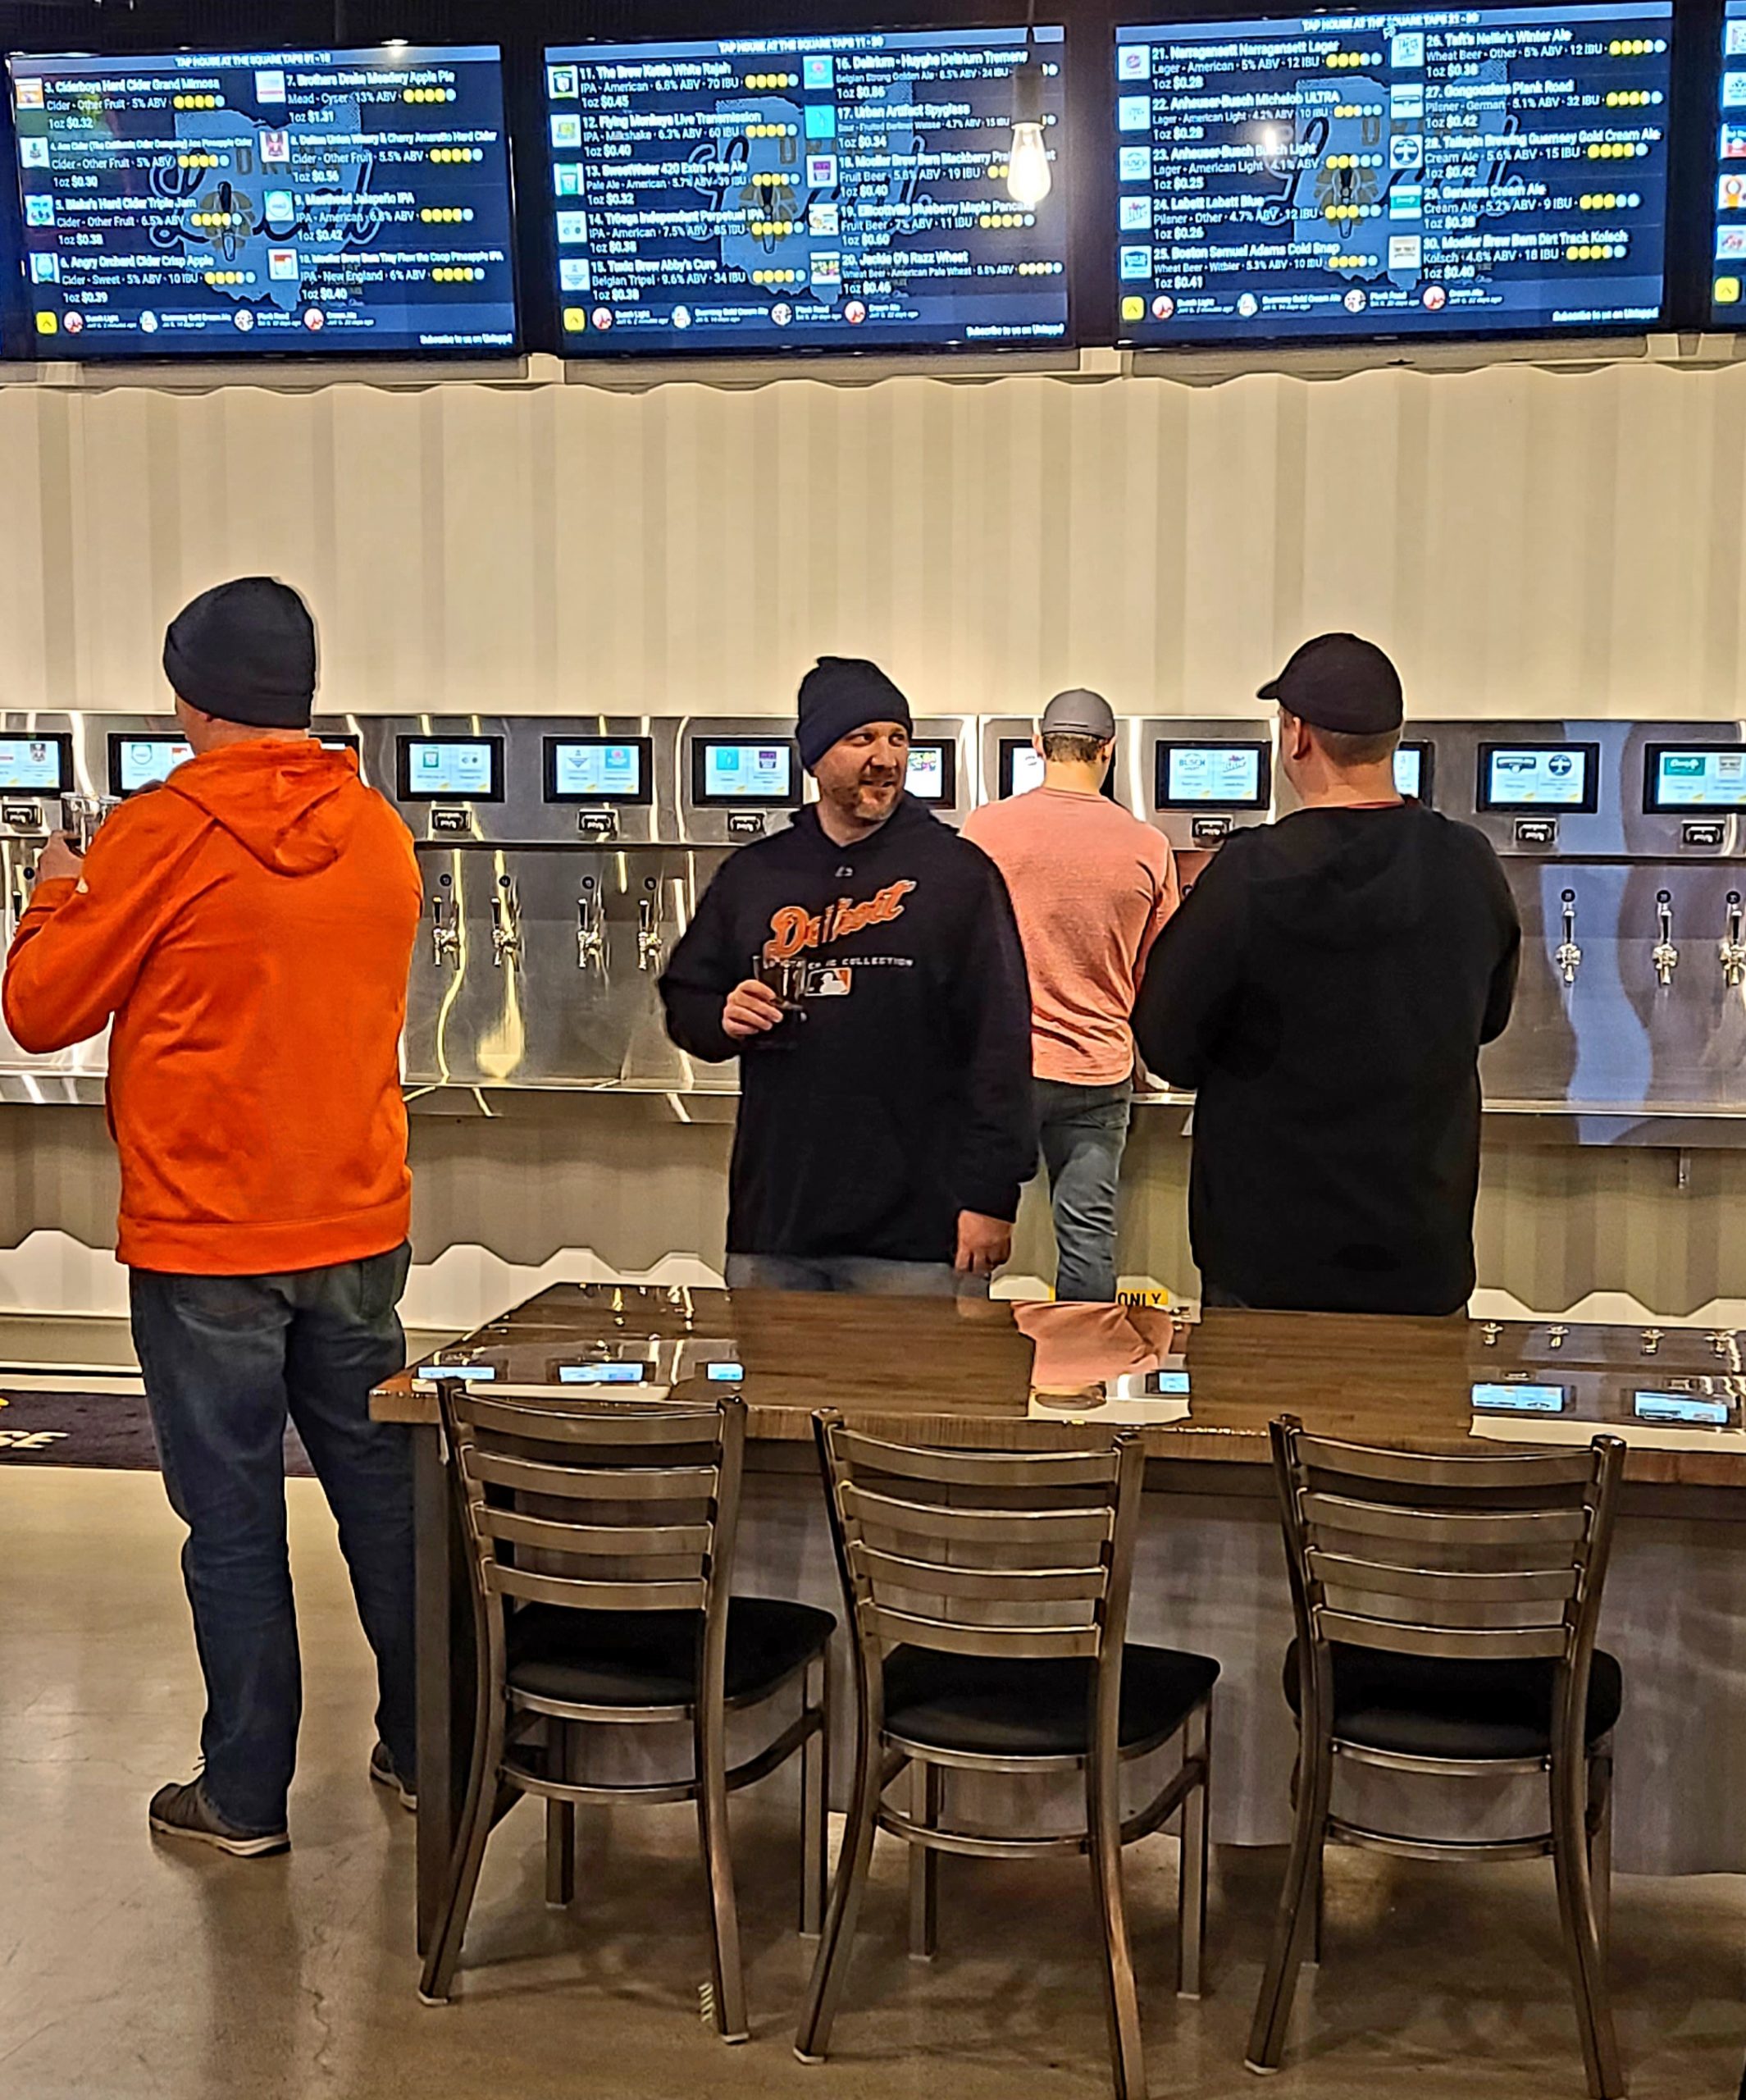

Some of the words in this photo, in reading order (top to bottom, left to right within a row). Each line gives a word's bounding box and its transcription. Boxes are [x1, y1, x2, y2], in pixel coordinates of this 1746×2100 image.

[1427, 51, 1457, 62] Wheat
[1460, 50, 1482, 60] Beer
[1489, 48, 1516, 58] Other
[1525, 47, 1539, 57] 5%
[1541, 45, 1562, 57] ABV
[1570, 44, 1583, 55] 12
[1584, 43, 1602, 54] IBU
[580, 67, 595, 80] 11.
[596, 66, 615, 79] The
[672, 64, 701, 76] White
[703, 62, 731, 76] Rajah
[1153, 64, 1180, 75] Lager
[1188, 62, 1233, 72] American
[1242, 59, 1256, 70] 5%
[1258, 58, 1279, 70] ABV
[1288, 57, 1300, 68] 12
[1302, 57, 1320, 67] IBU
[1427, 66, 1445, 77] 1oz
[410, 71, 437, 85] Apple
[438, 71, 454, 82] Pie
[581, 83, 597, 93] IPA
[604, 82, 649, 92] American
[680, 79, 700, 90] ABV
[707, 78, 720, 89] 70
[722, 77, 738, 89] IBU
[1153, 79, 1171, 89] 1oz
[47, 101, 71, 110] Cider
[78, 98, 102, 112] Other
[104, 98, 125, 109] Fruit
[132, 98, 146, 108] 5%
[148, 98, 166, 107] ABV
[288, 93, 314, 103] Mead
[321, 93, 349, 106] Cyser
[355, 92, 375, 103] 13%
[376, 91, 396, 102] ABV
[582, 98, 599, 107] 1oz
[601, 95, 629, 109] $0.45
[49, 119, 65, 129] 1oz
[66, 116, 93, 129] $0.32
[289, 112, 306, 125] 1oz
[308, 110, 333, 123] $1.31
[583, 116, 598, 129] 12.
[599, 116, 628, 130] Flying
[674, 114, 695, 126] Live
[695, 112, 761, 125] Transmission
[1426, 117, 1444, 128] 1oz
[1447, 114, 1477, 129] $0.42
[584, 131, 599, 142] IPA
[606, 130, 651, 140] Milkshake
[659, 129, 681, 139] 6.3%
[682, 128, 702, 139] ABV
[709, 127, 721, 140] 60
[723, 126, 739, 138] IBU
[839, 138, 856, 148] 1oz
[859, 135, 887, 148] $0.34
[585, 147, 602, 157] 1oz
[604, 144, 631, 158] $0.40
[293, 172, 310, 182] 1oz
[312, 170, 339, 182] $0.56
[1154, 179, 1172, 190] 1oz
[1174, 176, 1204, 190] $0.25
[1424, 188, 1441, 200] 29.
[1490, 183, 1525, 198] Cream
[1527, 183, 1546, 195] Ale
[588, 194, 604, 205] 1oz
[606, 193, 634, 205] $0.32
[1154, 199, 1169, 211] 24.
[1171, 197, 1205, 210] Labatt
[1206, 196, 1238, 208] Labatt
[1241, 195, 1265, 208] Blue
[1424, 203, 1458, 213] Cream
[1461, 201, 1479, 215] Ale
[1513, 199, 1536, 211] ABV
[1544, 198, 1551, 209] 9
[1553, 197, 1572, 208] IBU
[1154, 214, 1188, 225] Pilsner
[1195, 212, 1222, 222] Other
[1229, 211, 1253, 221] 4.7%
[1256, 209, 1279, 222] ABV
[1284, 209, 1298, 221] 12
[1300, 208, 1318, 219] IBU
[841, 220, 863, 231] Fruit
[865, 220, 887, 231] Beer
[893, 218, 911, 231] 7%
[912, 218, 932, 229] ABV
[941, 217, 951, 228] 11
[955, 217, 972, 228] IBU
[59, 235, 75, 244] 1oz
[298, 230, 314, 241] 1oz
[316, 229, 343, 241] $0.42
[842, 235, 859, 245] 1oz
[1155, 229, 1172, 240] 1oz
[1174, 226, 1204, 240] $0.26
[1154, 248, 1169, 260] 25.
[1172, 247, 1208, 259] Boston
[1249, 244, 1286, 256] Adams
[1288, 242, 1311, 255] Cold
[1313, 242, 1340, 255] Snap
[842, 254, 858, 266] 20.
[859, 253, 892, 266] Jackie
[910, 253, 935, 264] Razz
[936, 251, 968, 263] Wheat
[62, 275, 85, 285] Cider
[93, 275, 121, 284] Sweet
[127, 274, 140, 284] 5%
[142, 274, 162, 284] ABV
[169, 274, 180, 284] 10
[182, 272, 198, 283] IBU
[301, 272, 317, 282] IPA
[323, 272, 344, 281] New
[346, 270, 383, 284] England
[390, 270, 403, 281] 6%
[406, 269, 426, 280] ABV
[1424, 268, 1442, 279] 1oz
[1444, 265, 1475, 279] $0.40
[592, 276, 627, 288] Belgian
[628, 274, 655, 286] Tripel
[662, 274, 685, 284] 9.6%
[686, 273, 707, 284] ABV
[714, 272, 727, 283] 34
[729, 272, 745, 283] IBU
[1155, 278, 1172, 289] 1oz
[1174, 276, 1202, 289] $0.41
[302, 290, 319, 299] 1oz
[321, 287, 347, 300] $0.40
[844, 284, 861, 294] 1oz
[63, 293, 80, 303] 1oz
[81, 291, 107, 304] $0.39
[842, 956, 914, 967] COLLECTION
[1118, 1292, 1161, 1307] ONLY
